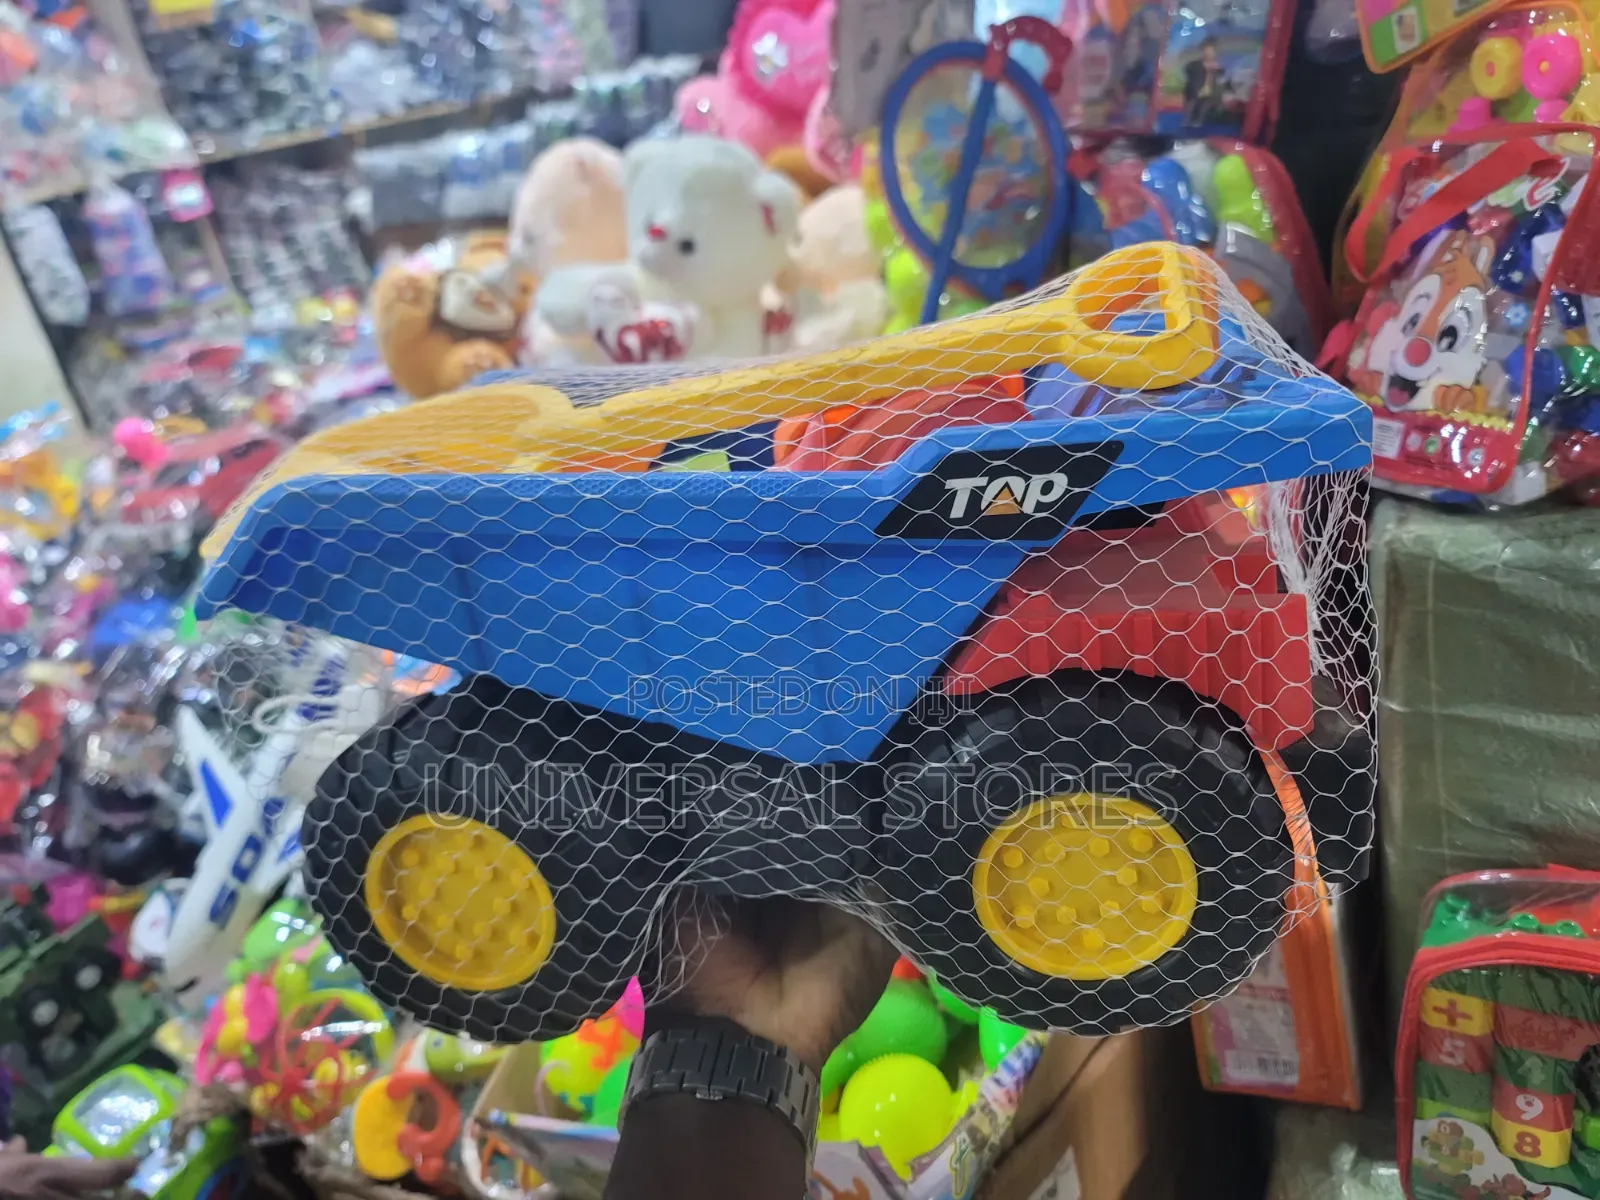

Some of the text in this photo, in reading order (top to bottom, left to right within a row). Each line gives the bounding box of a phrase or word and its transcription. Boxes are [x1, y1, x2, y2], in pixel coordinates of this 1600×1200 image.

[1438, 1037, 1466, 1066] 5
[1515, 1093, 1544, 1121] 9
[1514, 1131, 1542, 1158] 8
